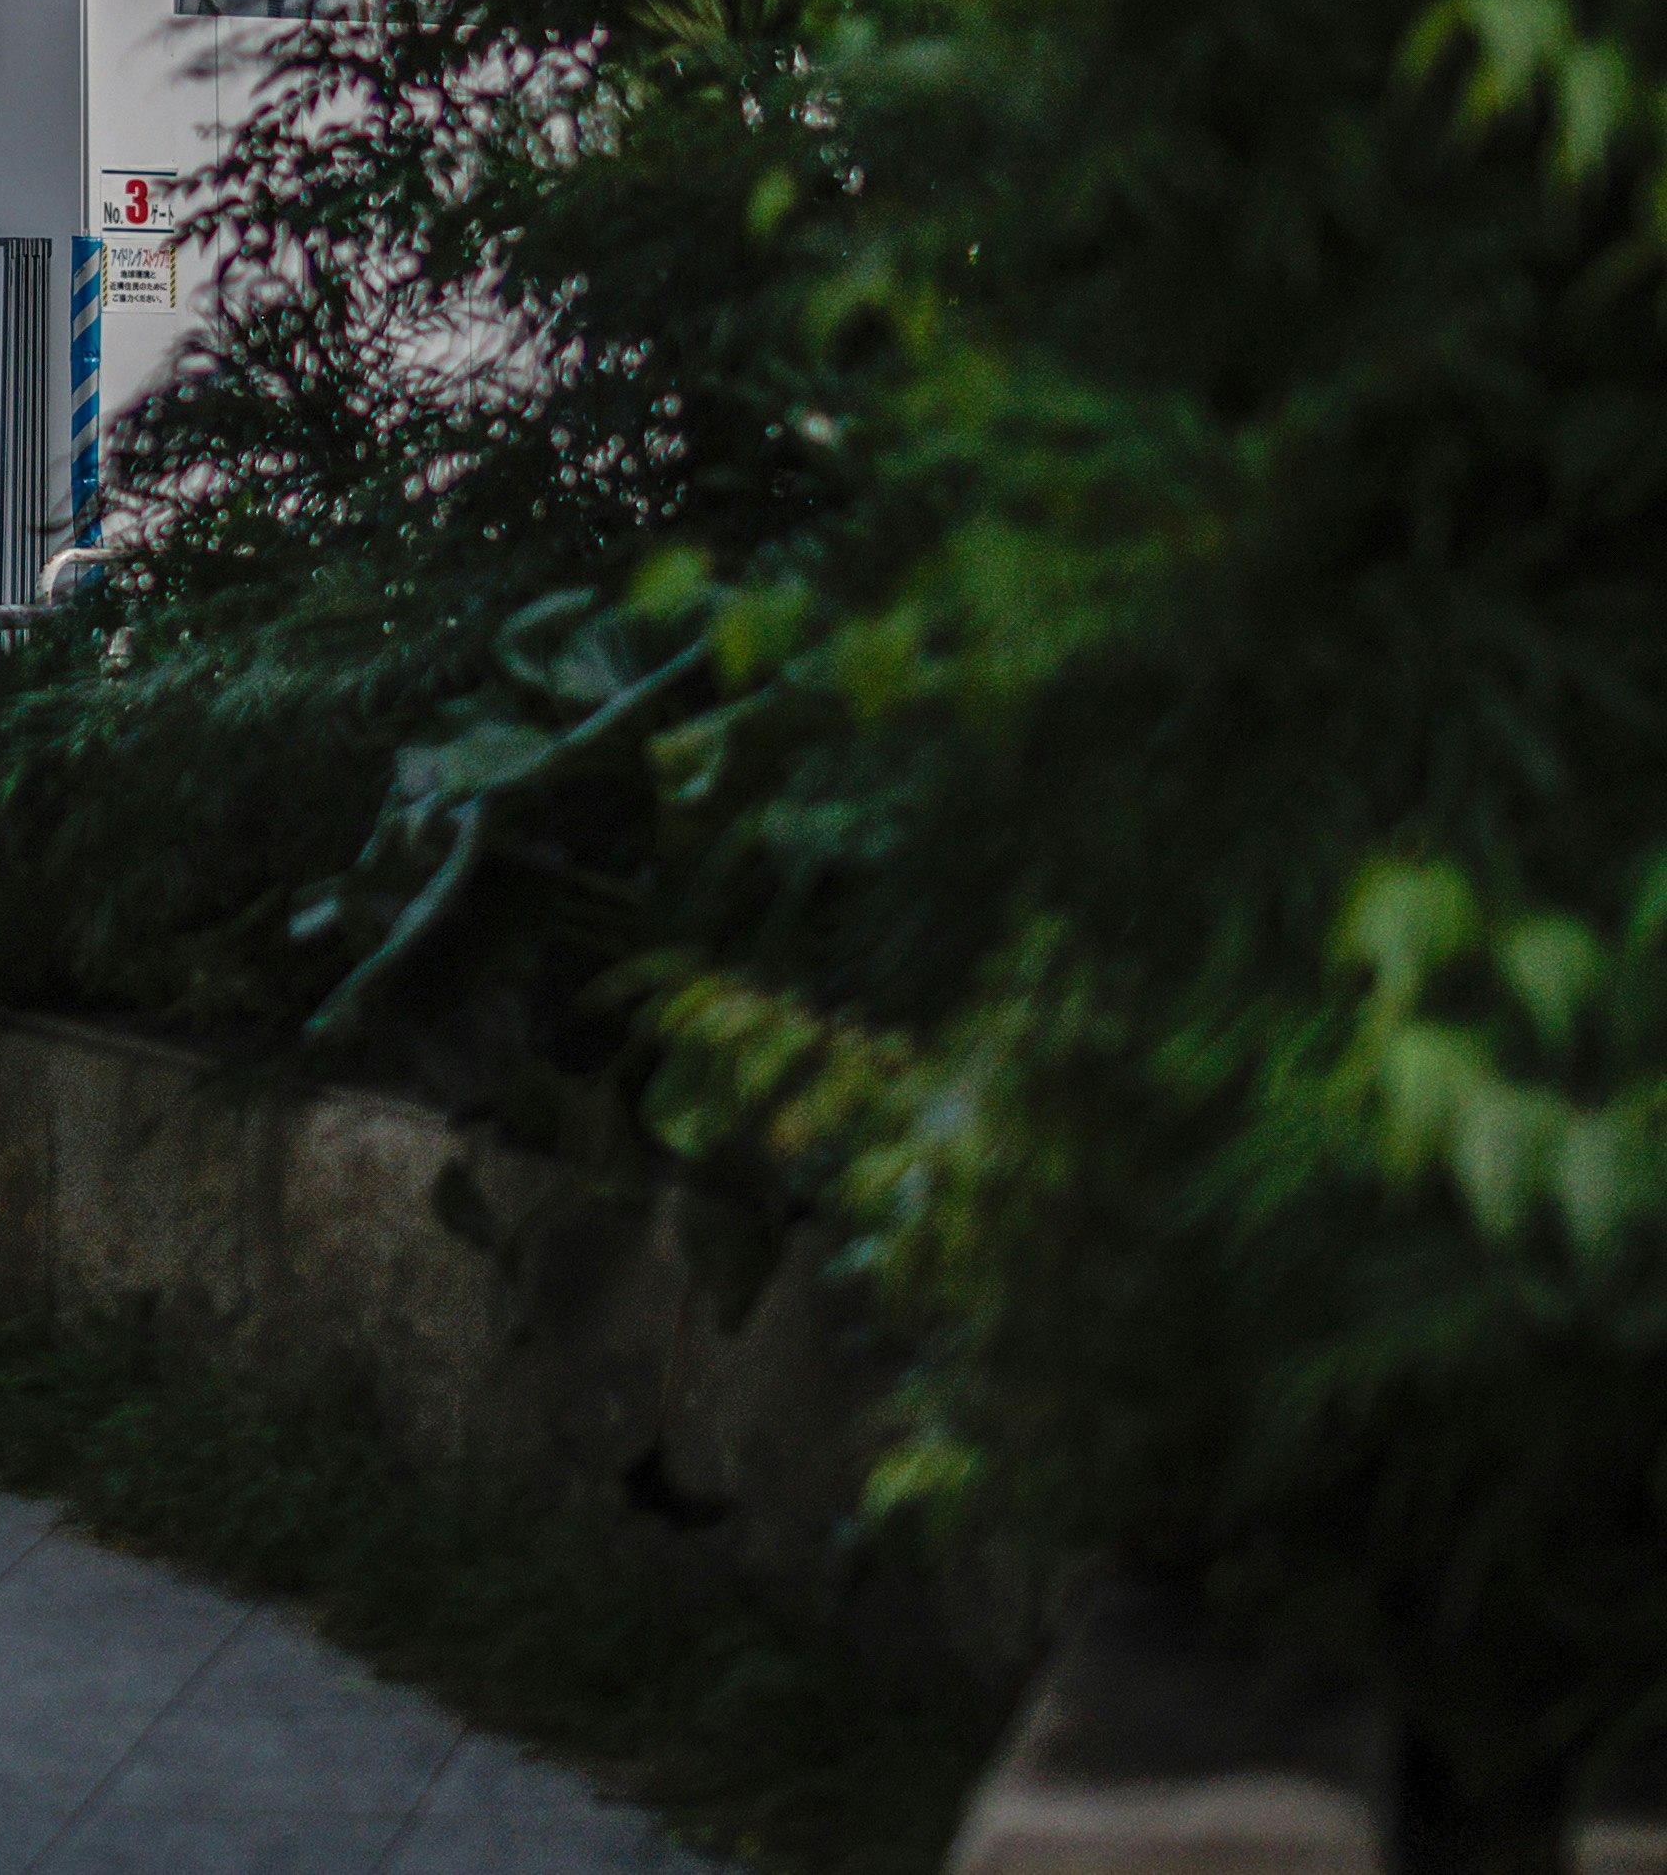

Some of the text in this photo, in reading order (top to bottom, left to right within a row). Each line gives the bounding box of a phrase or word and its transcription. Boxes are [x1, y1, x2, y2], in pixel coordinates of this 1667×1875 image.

[104, 178, 174, 225] No. 3 ゲート
